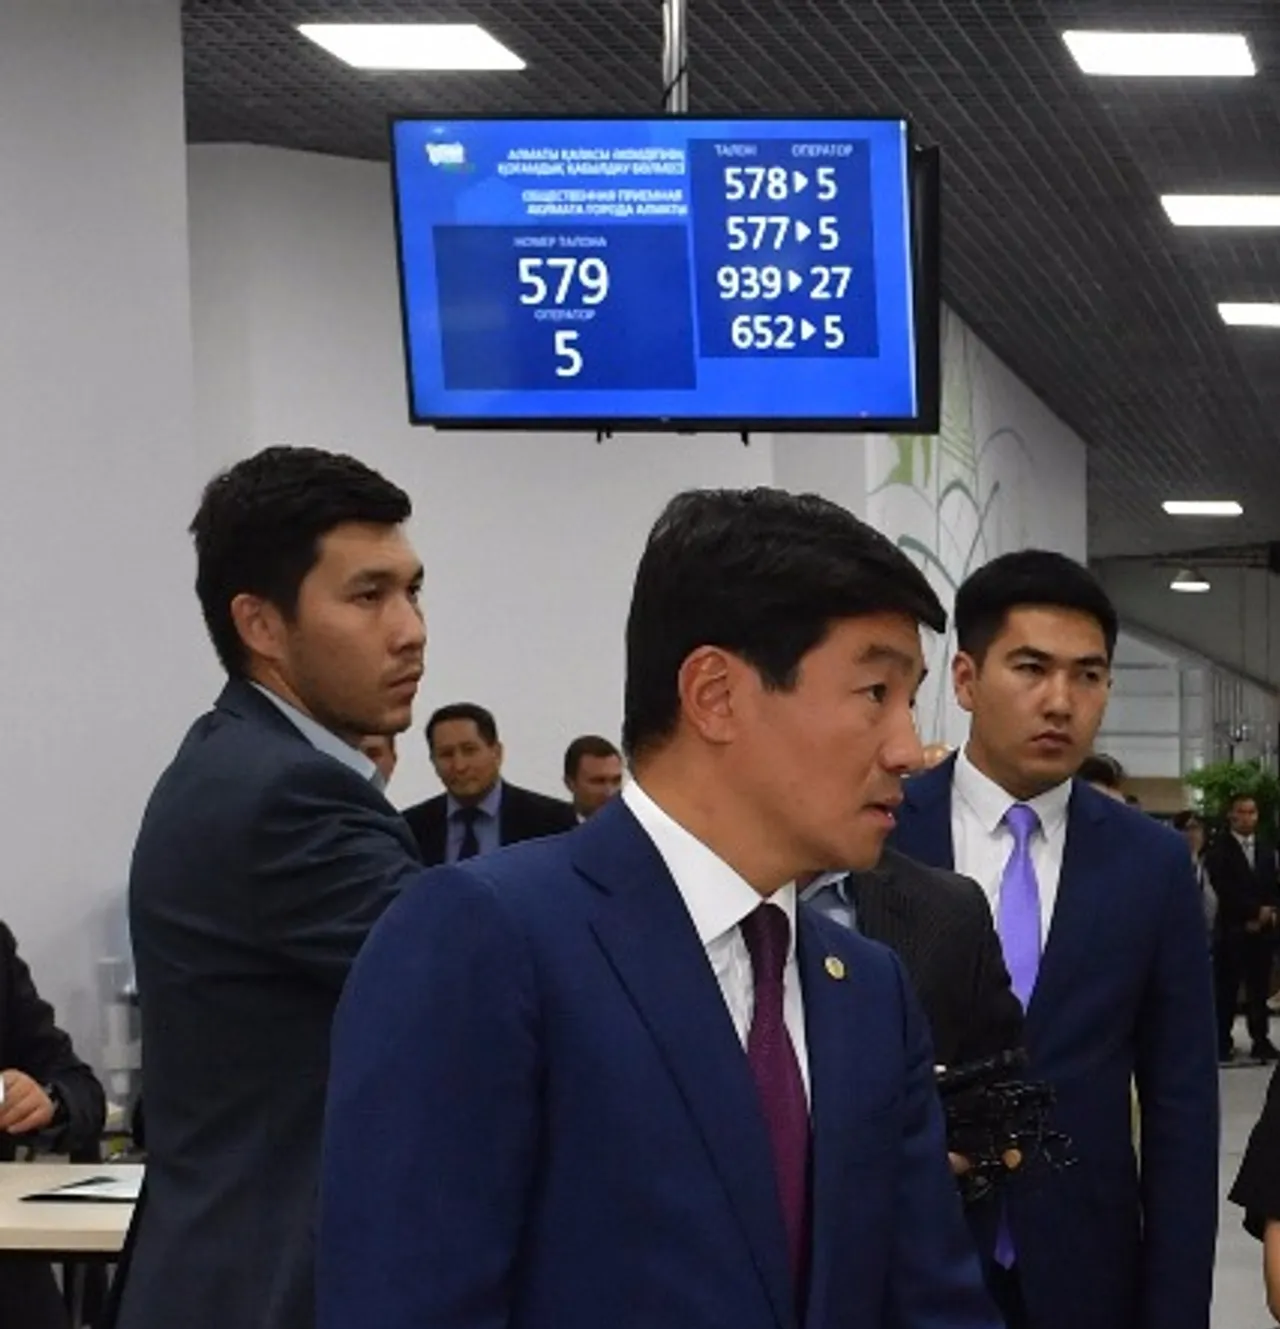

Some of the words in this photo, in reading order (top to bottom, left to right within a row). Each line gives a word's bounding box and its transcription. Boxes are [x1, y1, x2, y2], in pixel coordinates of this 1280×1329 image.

[724, 166, 788, 200] 578
[816, 167, 838, 200] 5
[726, 216, 790, 251] 577
[818, 216, 840, 251] 5
[518, 257, 610, 305] 579
[716, 266, 782, 299] 939
[809, 266, 853, 299] 27
[731, 314, 796, 349] 652
[823, 314, 845, 349] 5
[554, 329, 583, 377] 5
